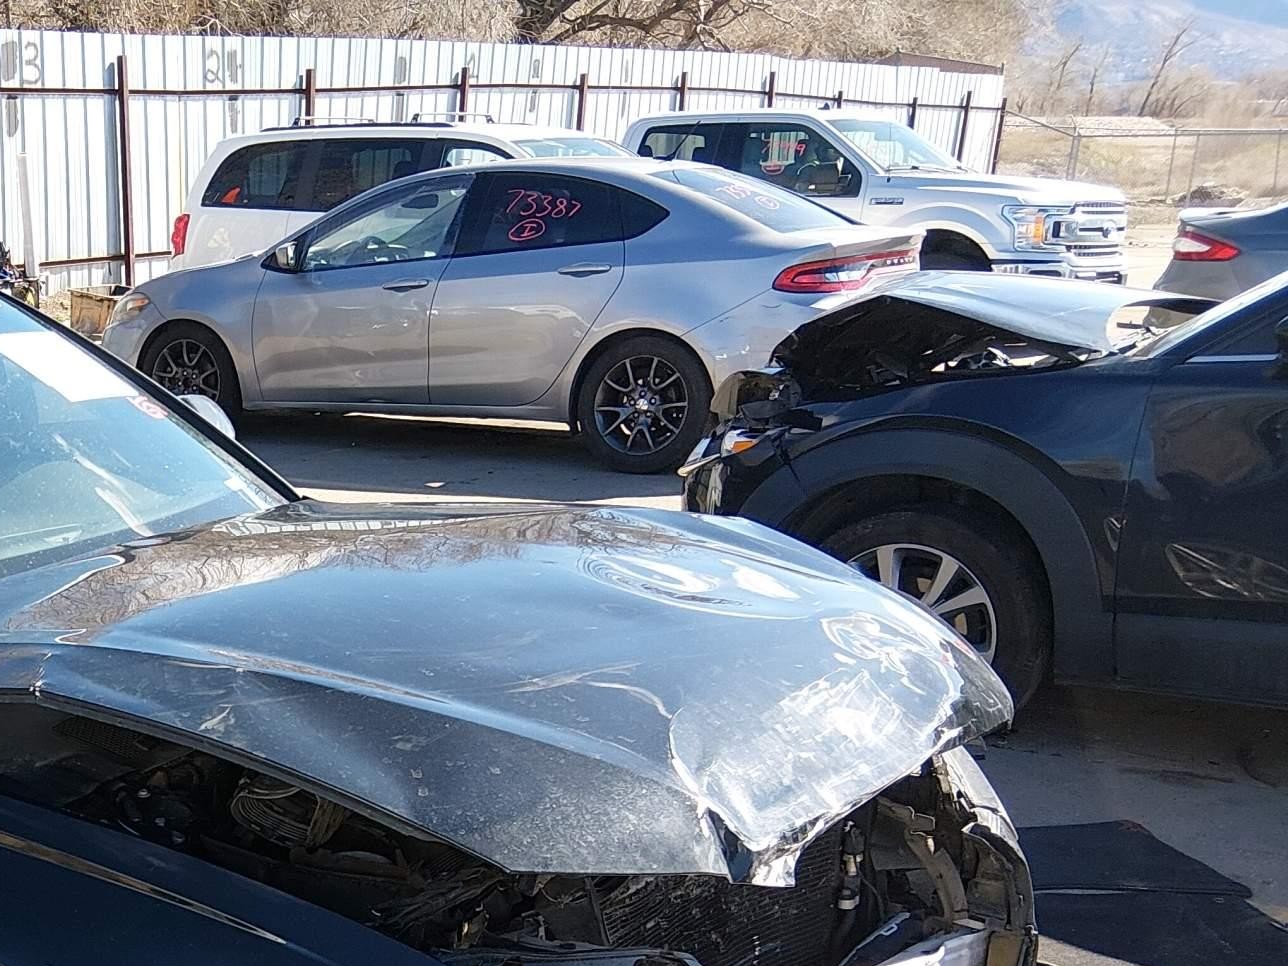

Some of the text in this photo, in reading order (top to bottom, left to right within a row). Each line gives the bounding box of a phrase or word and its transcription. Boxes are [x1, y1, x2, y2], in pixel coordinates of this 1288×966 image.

[23, 41, 41, 85] 3
[205, 48, 224, 84] 2
[506, 188, 583, 218] 73387
